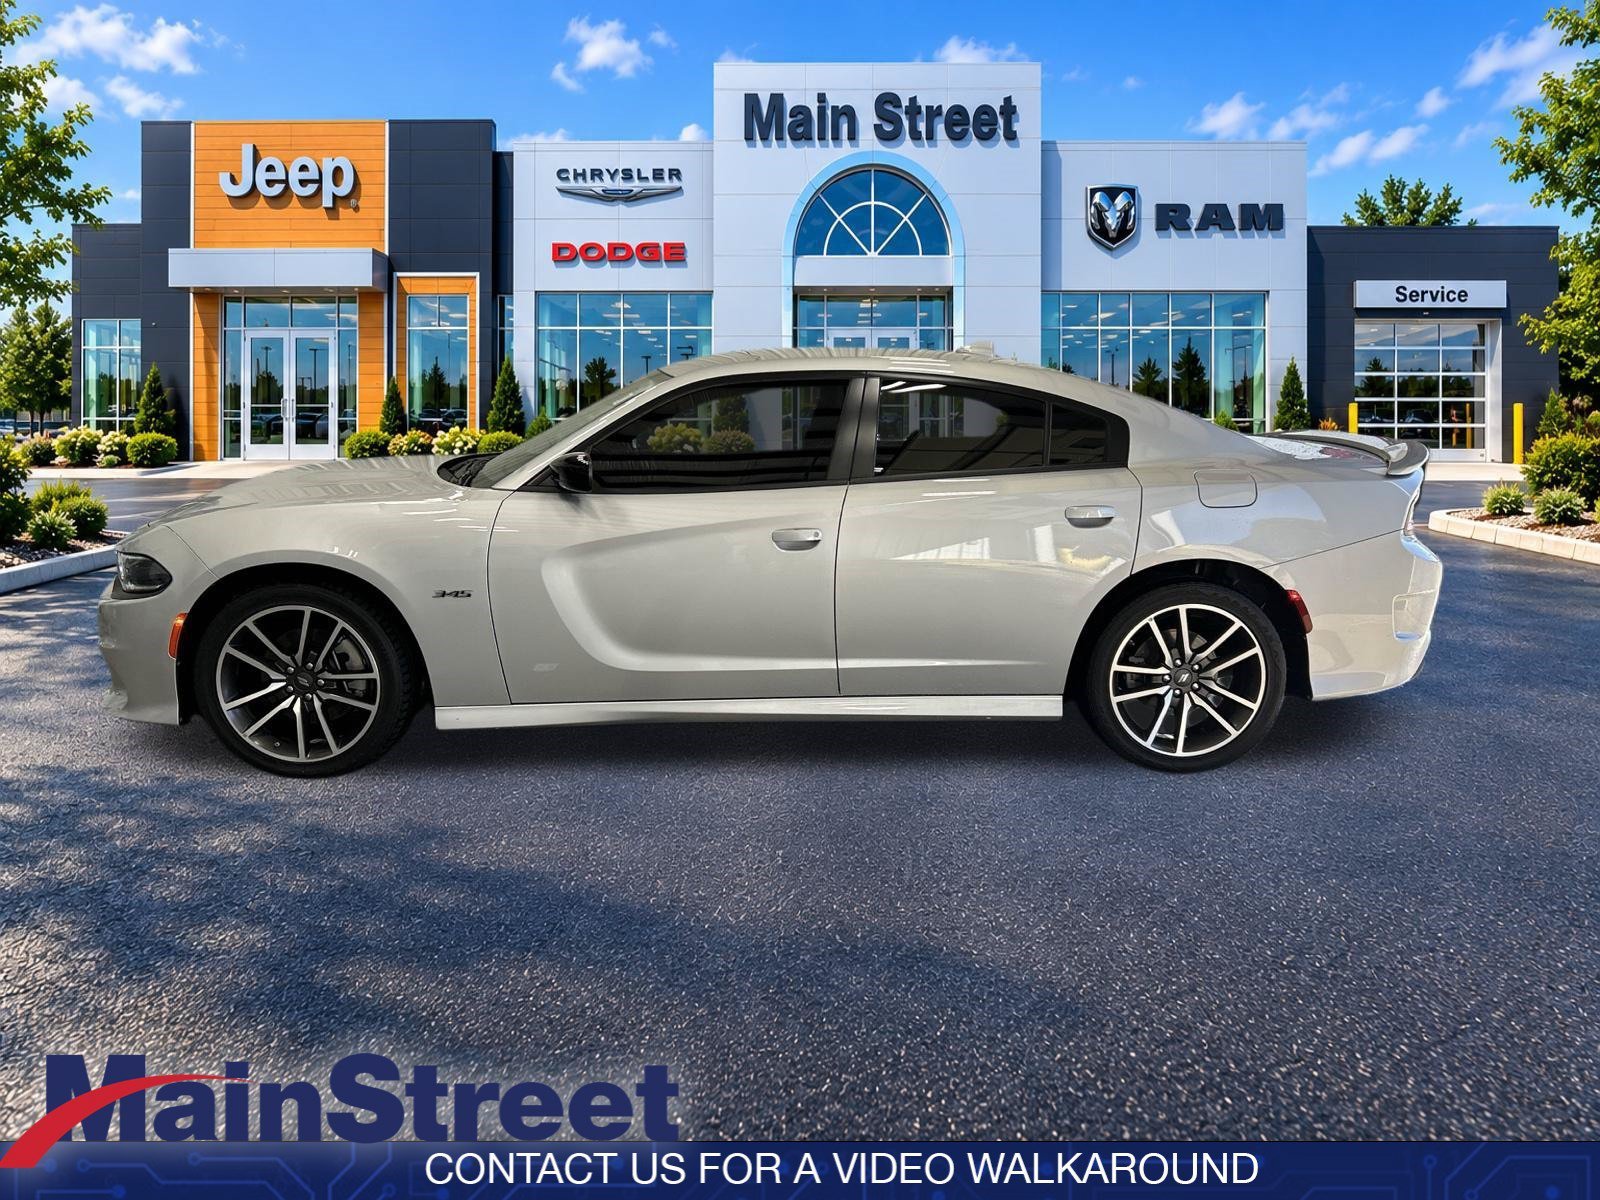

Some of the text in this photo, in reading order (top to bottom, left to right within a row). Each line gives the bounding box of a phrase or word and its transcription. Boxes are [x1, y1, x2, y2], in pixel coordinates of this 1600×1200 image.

[744, 92, 1017, 141] Main Street
[218, 143, 355, 208] Jeep
[556, 168, 682, 182] CHRYSLER
[1155, 203, 1284, 231] RAM
[552, 242, 687, 262] DODGE
[1395, 285, 1469, 303] Service
[432, 589, 473, 598] 345
